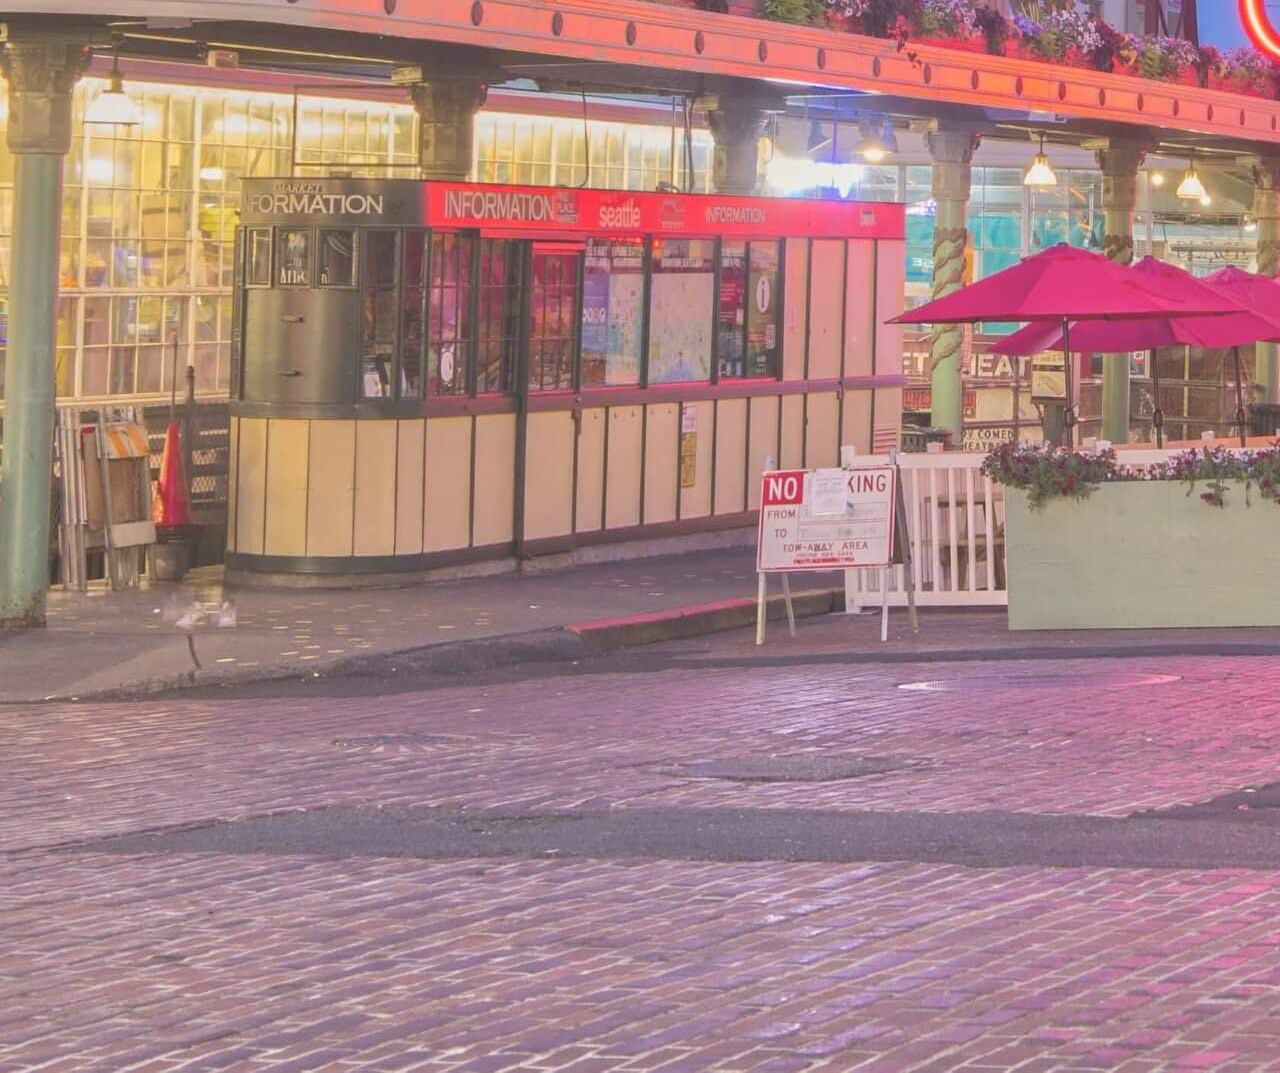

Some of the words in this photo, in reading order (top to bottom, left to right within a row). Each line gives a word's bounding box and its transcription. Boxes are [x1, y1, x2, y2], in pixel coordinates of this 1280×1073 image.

[444, 191, 555, 222] INFORMATION
[599, 198, 641, 227] seattle
[705, 206, 766, 223] INFORMATION
[768, 476, 798, 501] NO
[767, 510, 796, 520] FROM
[774, 528, 787, 539] TO
[783, 542, 834, 553] TOW-AWAY
[842, 541, 869, 550] AREA
